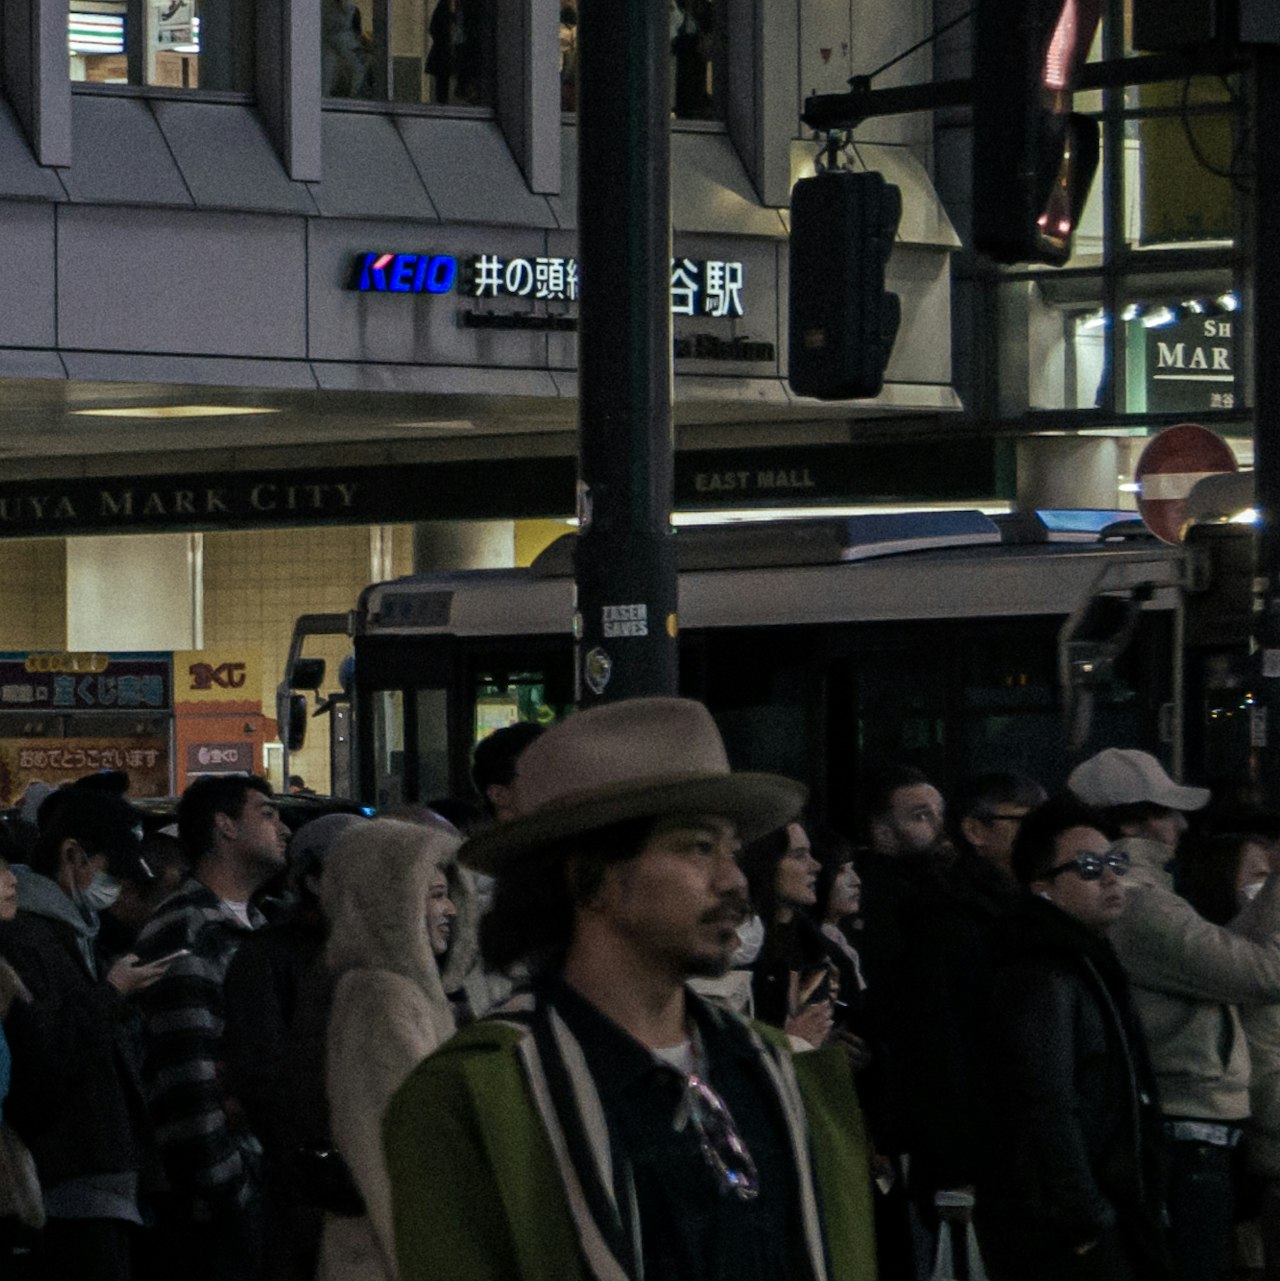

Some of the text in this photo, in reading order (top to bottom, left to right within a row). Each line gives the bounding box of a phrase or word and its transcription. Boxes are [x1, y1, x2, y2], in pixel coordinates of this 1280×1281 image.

[359, 253, 457, 294] KEIO
[671, 259, 743, 317] 谷駅
[1204, 320, 1231, 337] SH
[1157, 342, 1231, 370] MAR
[1210, 392, 1234, 409] 渋谷
[694, 468, 816, 491] EAST MALL
[99, 487, 231, 518] MARK
[251, 482, 361, 512] CITY
[19, 748, 160, 769] おめでとうございます
